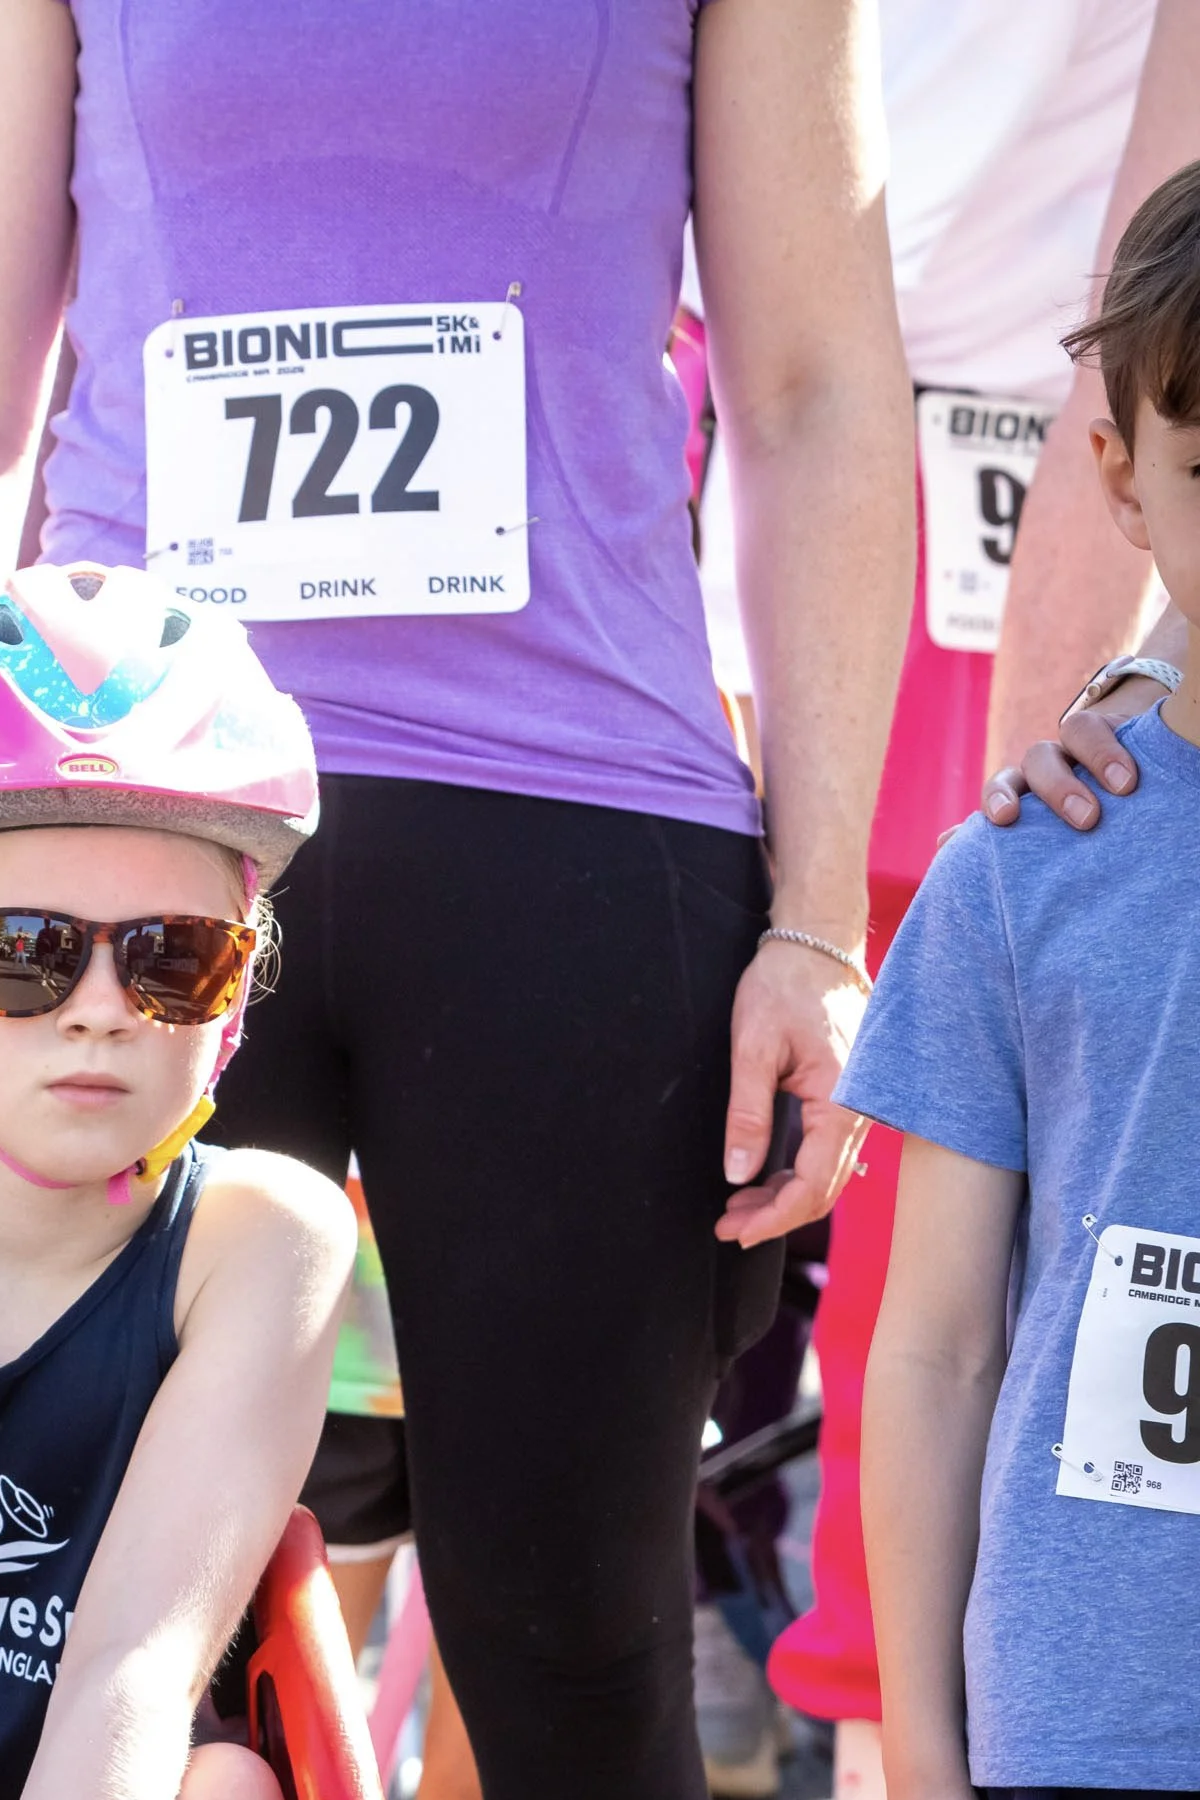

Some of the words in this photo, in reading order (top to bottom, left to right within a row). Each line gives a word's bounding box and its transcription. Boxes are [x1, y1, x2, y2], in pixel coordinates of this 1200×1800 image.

[184, 316, 434, 371] BIONIC
[224, 383, 441, 523] 722
[977, 467, 1028, 565] 9
[301, 579, 377, 600] DRINK
[429, 575, 505, 594] DRINK
[68, 764, 108, 772] BELL
[1128, 1289, 1191, 1306] CAMBRIDGE
[1146, 1479, 1162, 1490] 968
